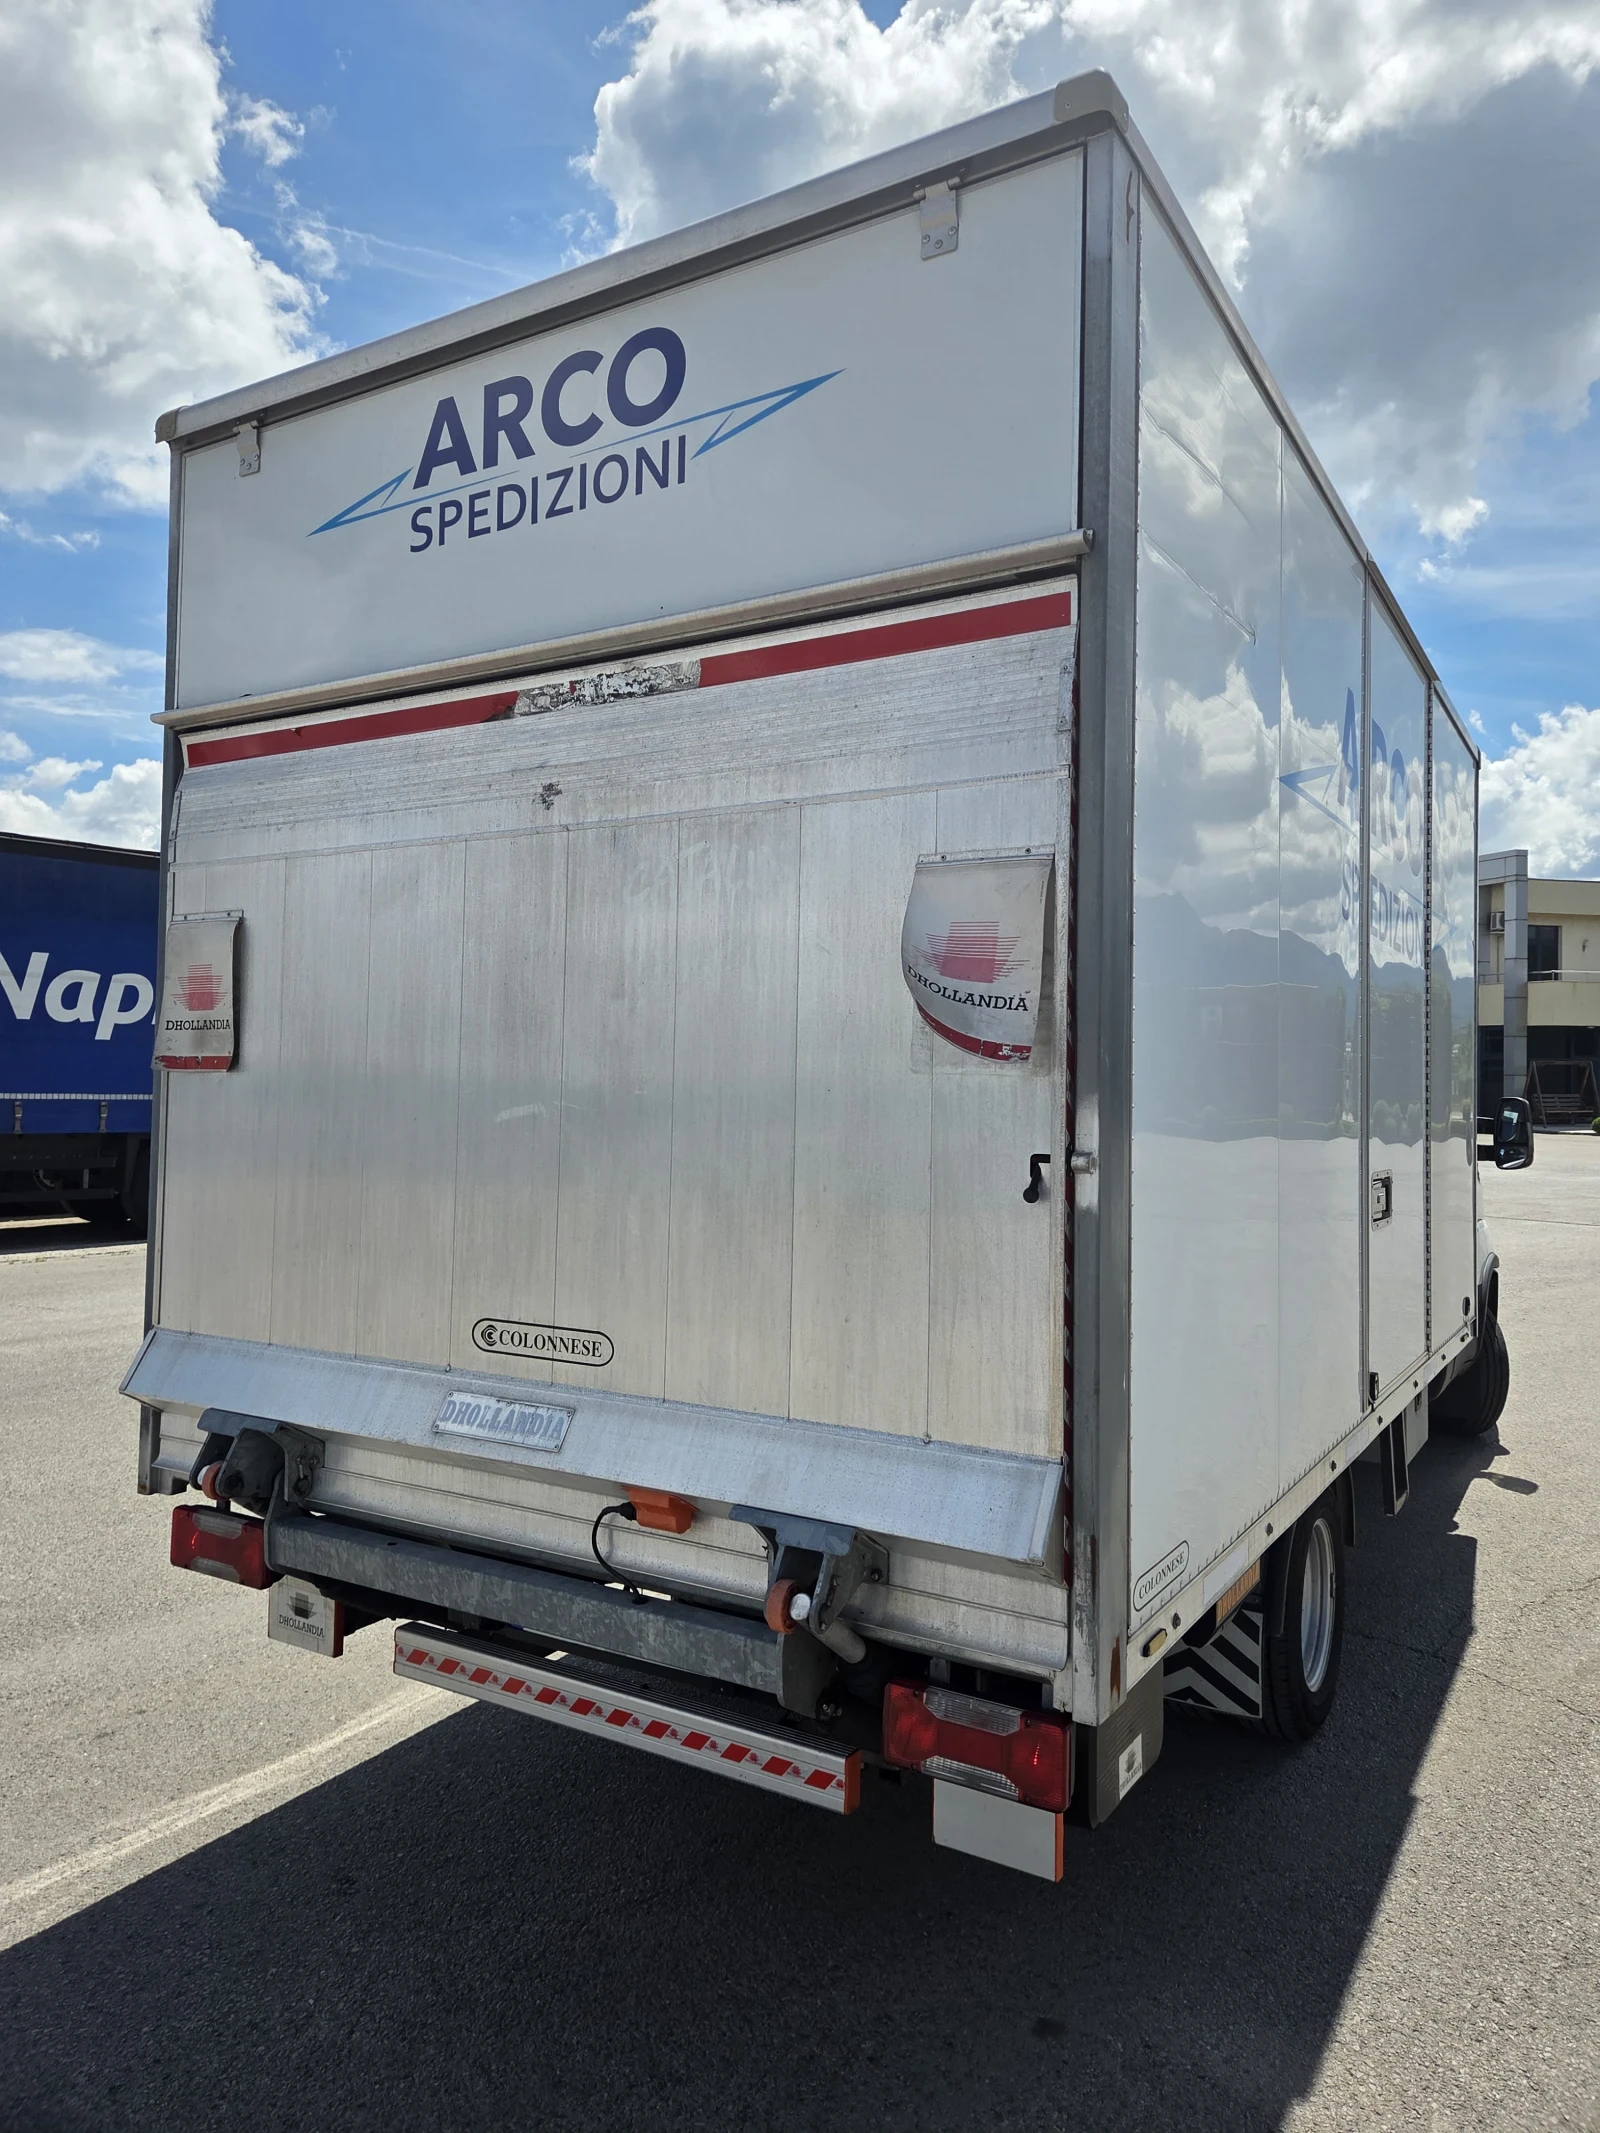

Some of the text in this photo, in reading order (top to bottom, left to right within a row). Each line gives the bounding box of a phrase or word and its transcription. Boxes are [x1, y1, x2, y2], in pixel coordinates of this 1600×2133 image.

[412, 326, 687, 490] ARCO
[410, 435, 687, 553] SPEDIZIONI
[1337, 686, 1425, 877] ARCO
[0, 951, 156, 1041] Nap
[908, 964, 1029, 1012] DHOLLANDIA
[165, 1019, 231, 1031] DHOLLANDIA
[499, 1329, 603, 1358] COLONNESE
[439, 1399, 566, 1441] DHOLLANDIA
[1138, 1550, 1185, 1600] COLONNESE
[278, 1613, 325, 1638] DHOLLANDIA
